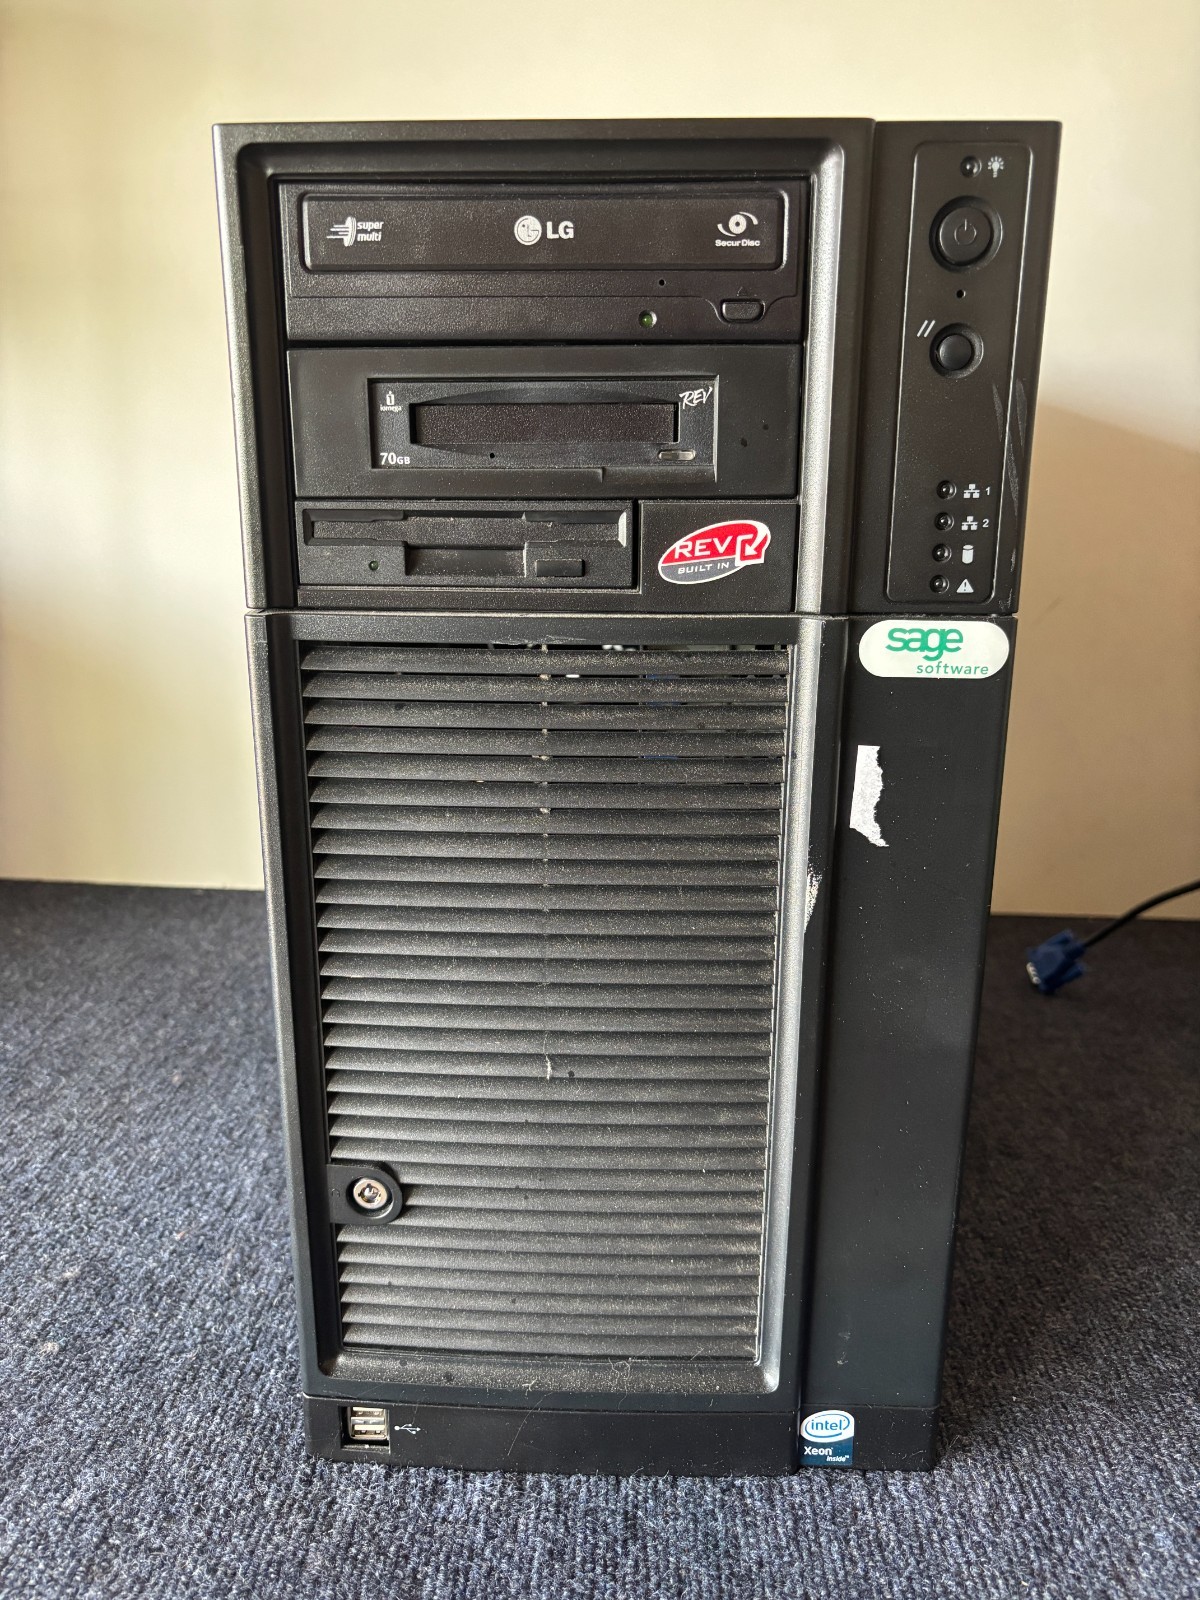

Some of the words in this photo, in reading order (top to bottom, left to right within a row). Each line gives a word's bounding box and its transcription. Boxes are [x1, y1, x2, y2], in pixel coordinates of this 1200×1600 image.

[357, 221, 384, 231] super
[546, 220, 574, 239] LG
[357, 231, 382, 241] multi
[679, 386, 713, 409] REV
[380, 452, 410, 465] 70GB
[985, 486, 991, 496] 1
[982, 518, 989, 528] 2
[674, 535, 733, 559] REV
[678, 563, 713, 574] BUILT
[717, 561, 730, 570] IN
[885, 627, 963, 661] sage
[916, 661, 989, 675] software
[811, 1419, 843, 1431] intel
[803, 1446, 833, 1456] Xeon
